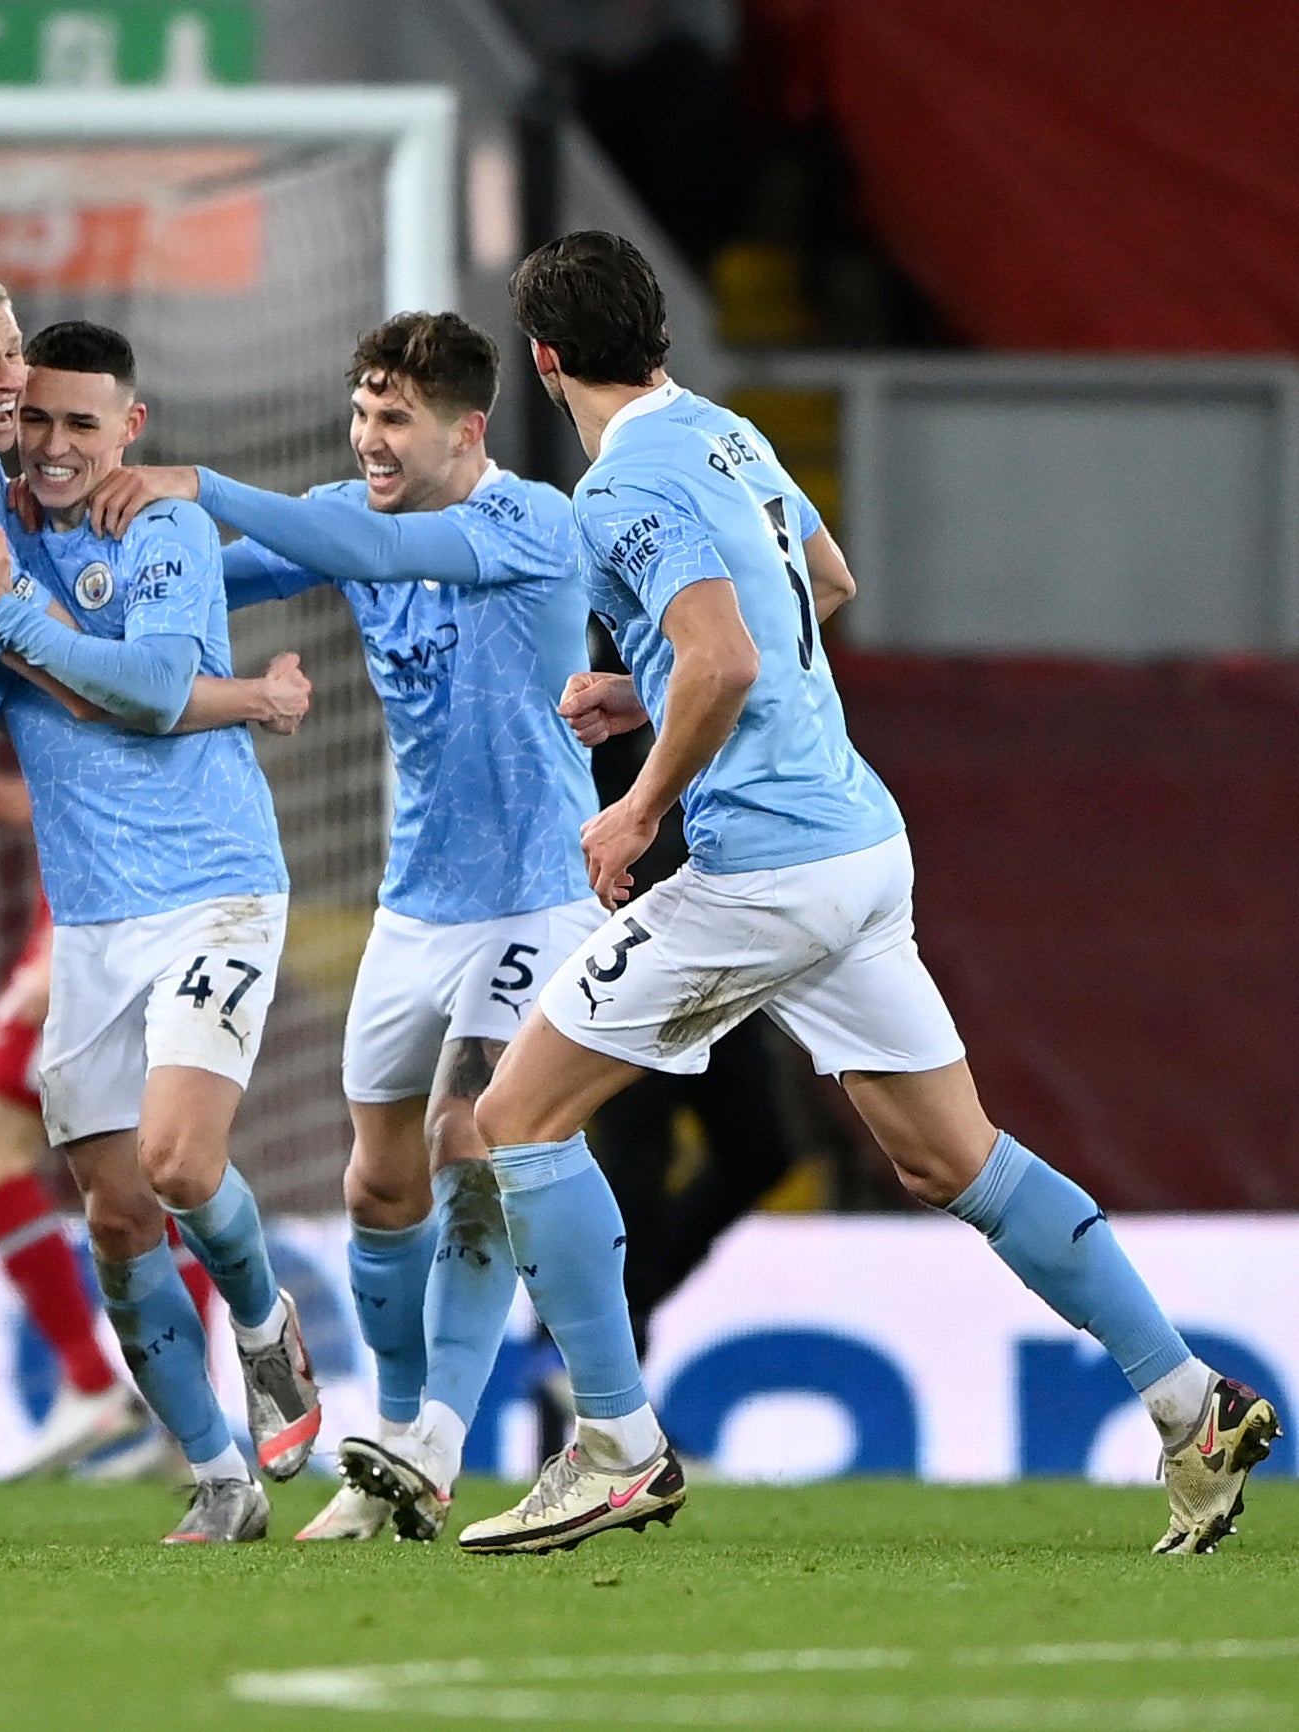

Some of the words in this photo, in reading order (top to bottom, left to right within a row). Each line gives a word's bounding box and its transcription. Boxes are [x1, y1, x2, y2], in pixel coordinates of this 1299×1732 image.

[609, 513, 661, 569] NEXEN
[627, 537, 659, 577] TIRE
[490, 942, 539, 991] 5
[585, 916, 653, 983] 3
[174, 955, 263, 1016] 47
